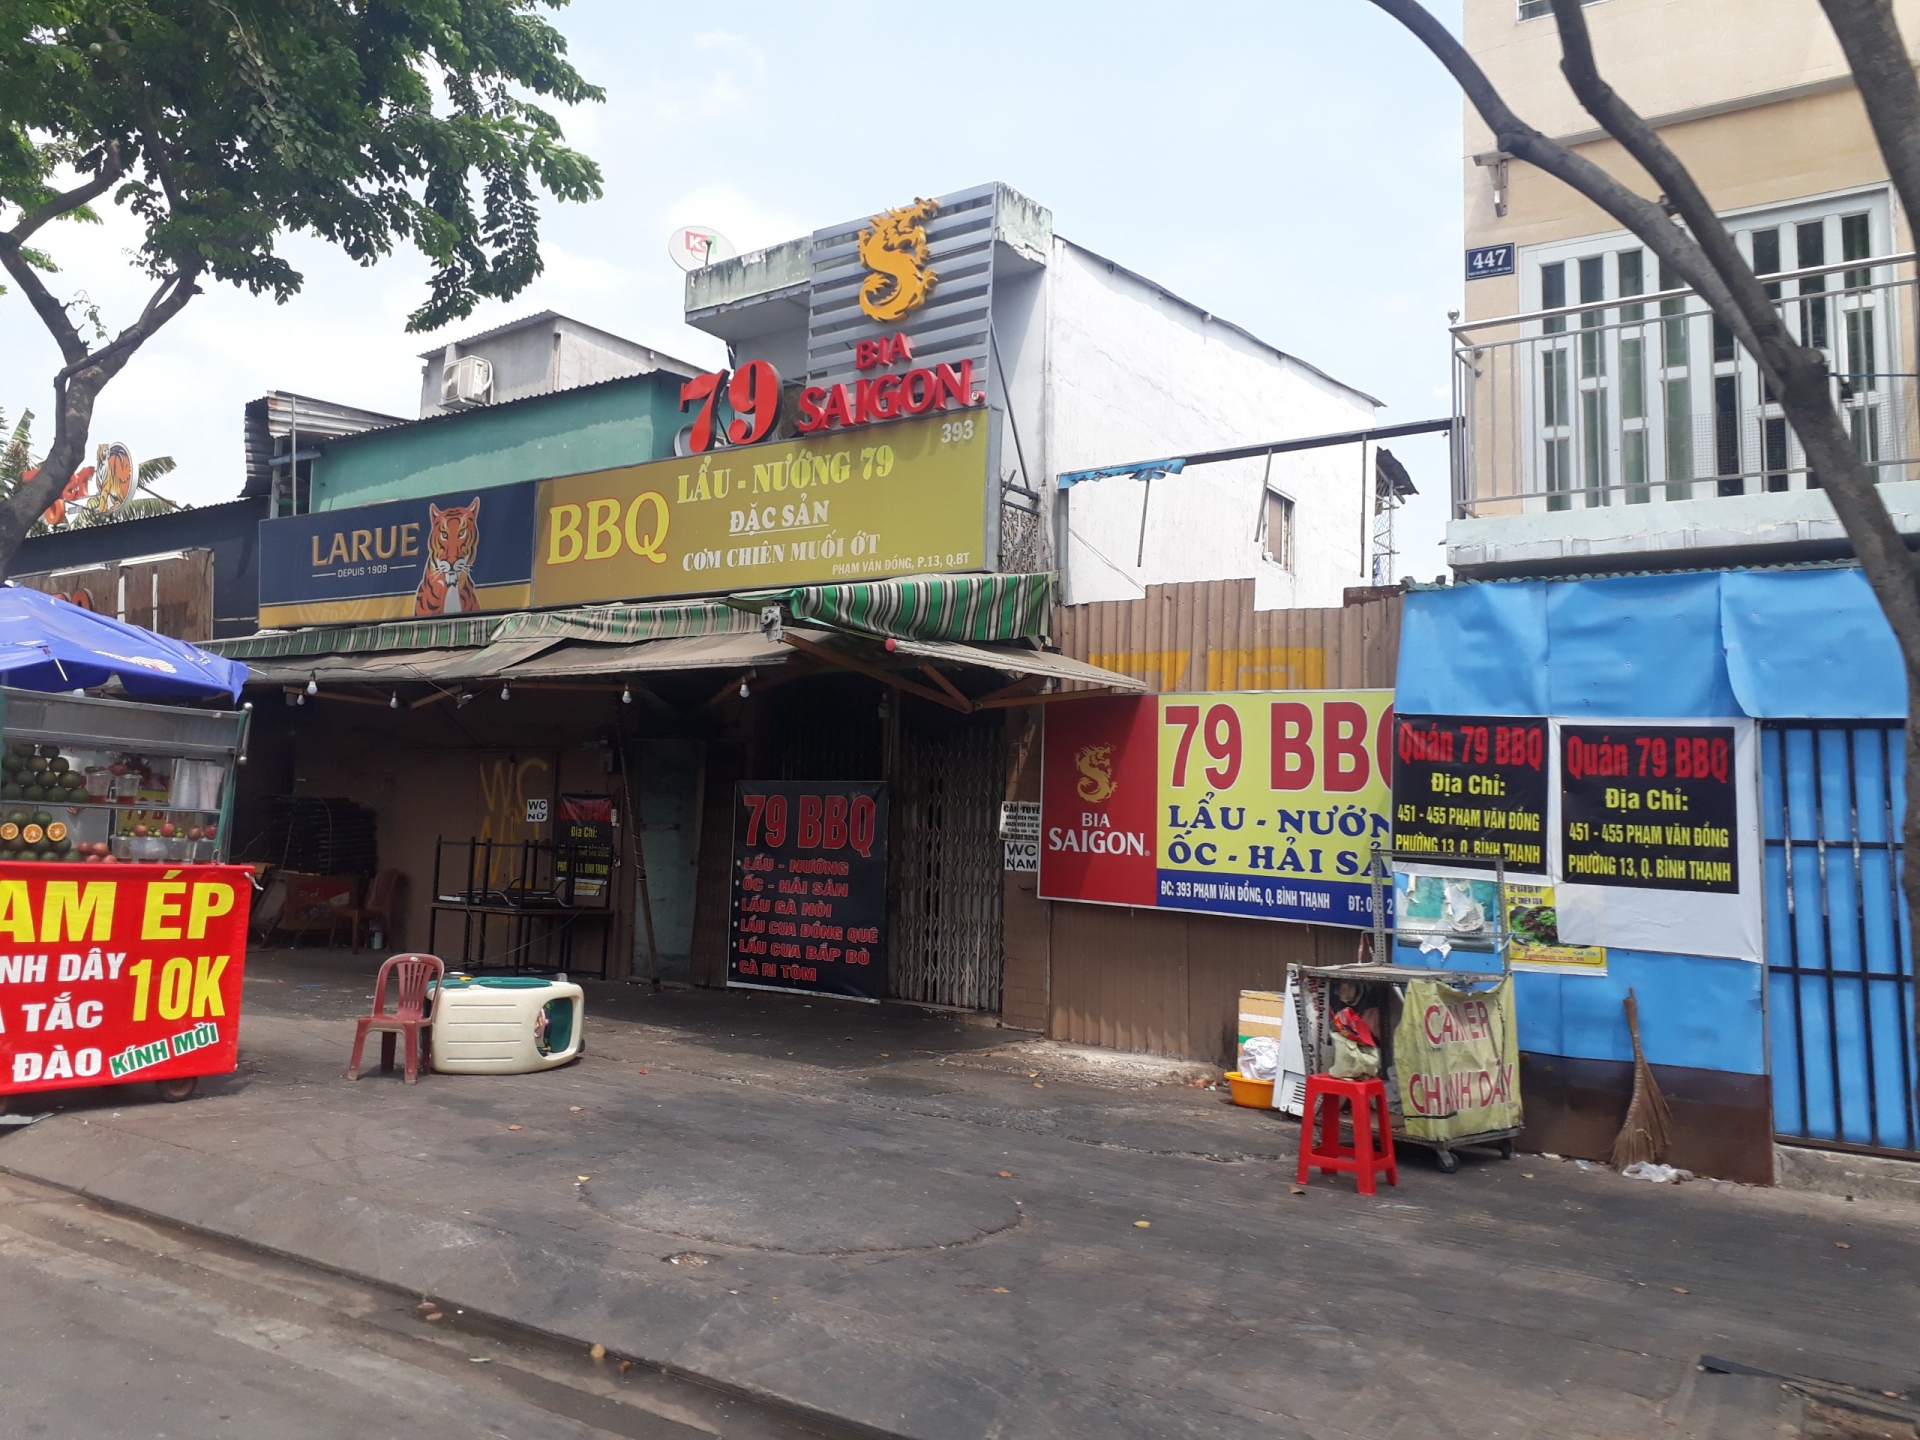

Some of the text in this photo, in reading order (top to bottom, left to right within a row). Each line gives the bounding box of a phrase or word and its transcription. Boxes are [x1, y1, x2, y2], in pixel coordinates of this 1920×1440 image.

[1473, 249, 1506, 269] 447
[855, 332, 913, 370] BIA
[679, 359, 784, 453] 79
[798, 358, 974, 433] SAIGON
[941, 420, 974, 443] 393
[677, 456, 731, 504] LẨU
[752, 449, 850, 493] NƯỚNG
[861, 445, 894, 480] 79
[547, 491, 670, 564] BBQ
[729, 493, 829, 535] ĐẶC SẢN
[312, 523, 420, 567] LARUE
[683, 530, 880, 571] CƠM CHIÊN MUỐI ỚT
[337, 564, 388, 578] DEPUIS 1909
[832, 552, 970, 576] PHẠM VĂN ĐỒNG, P.13, Q.BT
[1165, 702, 1243, 791] 79
[1398, 722, 1543, 771] Quán 79 BBQ
[1567, 735, 1728, 783] Quán 79 BBQ
[1431, 772, 1505, 797] Địa Chỉ:
[1605, 788, 1689, 813] Địa Chỉ:
[528, 801, 546, 810] WC
[1081, 812, 1111, 828] BIA
[1168, 792, 1246, 830] LẨU
[1397, 804, 1416, 822] 451
[1426, 806, 1446, 824] 455
[1449, 808, 1480, 831] PHẠM
[1483, 808, 1506, 829] VĂN
[1509, 806, 1540, 832] ĐỒNG
[571, 825, 582, 840] Địa
[744, 795, 876, 857] 79 BBQ
[1048, 827, 1145, 856] SAIGON
[1569, 822, 1589, 841] 451
[1602, 824, 1623, 843] 455
[1626, 825, 1662, 848] PHẠM
[1665, 823, 1690, 845] VĂN
[1693, 821, 1729, 848] ĐỒNG
[1007, 844, 1036, 856] WC
[1007, 859, 1036, 869] NAM
[1168, 830, 1218, 866] ỐC
[1248, 836, 1323, 873] HẢI
[1568, 851, 1731, 885] PHƯỜNG 13, Q. BÌNH THẠNH
[779, 877, 808, 895] HẢI
[812, 878, 848, 897] SẢN
[1161, 880, 1330, 912] ĐC: 393 PHẠM VĂN ĐỒNG, Q. BÌNH THẠNH
[1348, 895, 1364, 912] ĐT:
[141, 870, 235, 940] ÉP
[775, 899, 797, 915] GÀ
[769, 921, 796, 936] CUA
[847, 927, 878, 943] QUÊ
[57, 947, 126, 982] DÂY
[770, 943, 801, 958] CUA
[739, 959, 817, 981] CÀ RI TÔM
[129, 955, 230, 1022] 10K
[21, 992, 104, 1032] TẮC
[12, 1045, 103, 1082] ĐÀO
[110, 1022, 219, 1077] KÍNH MỜI
